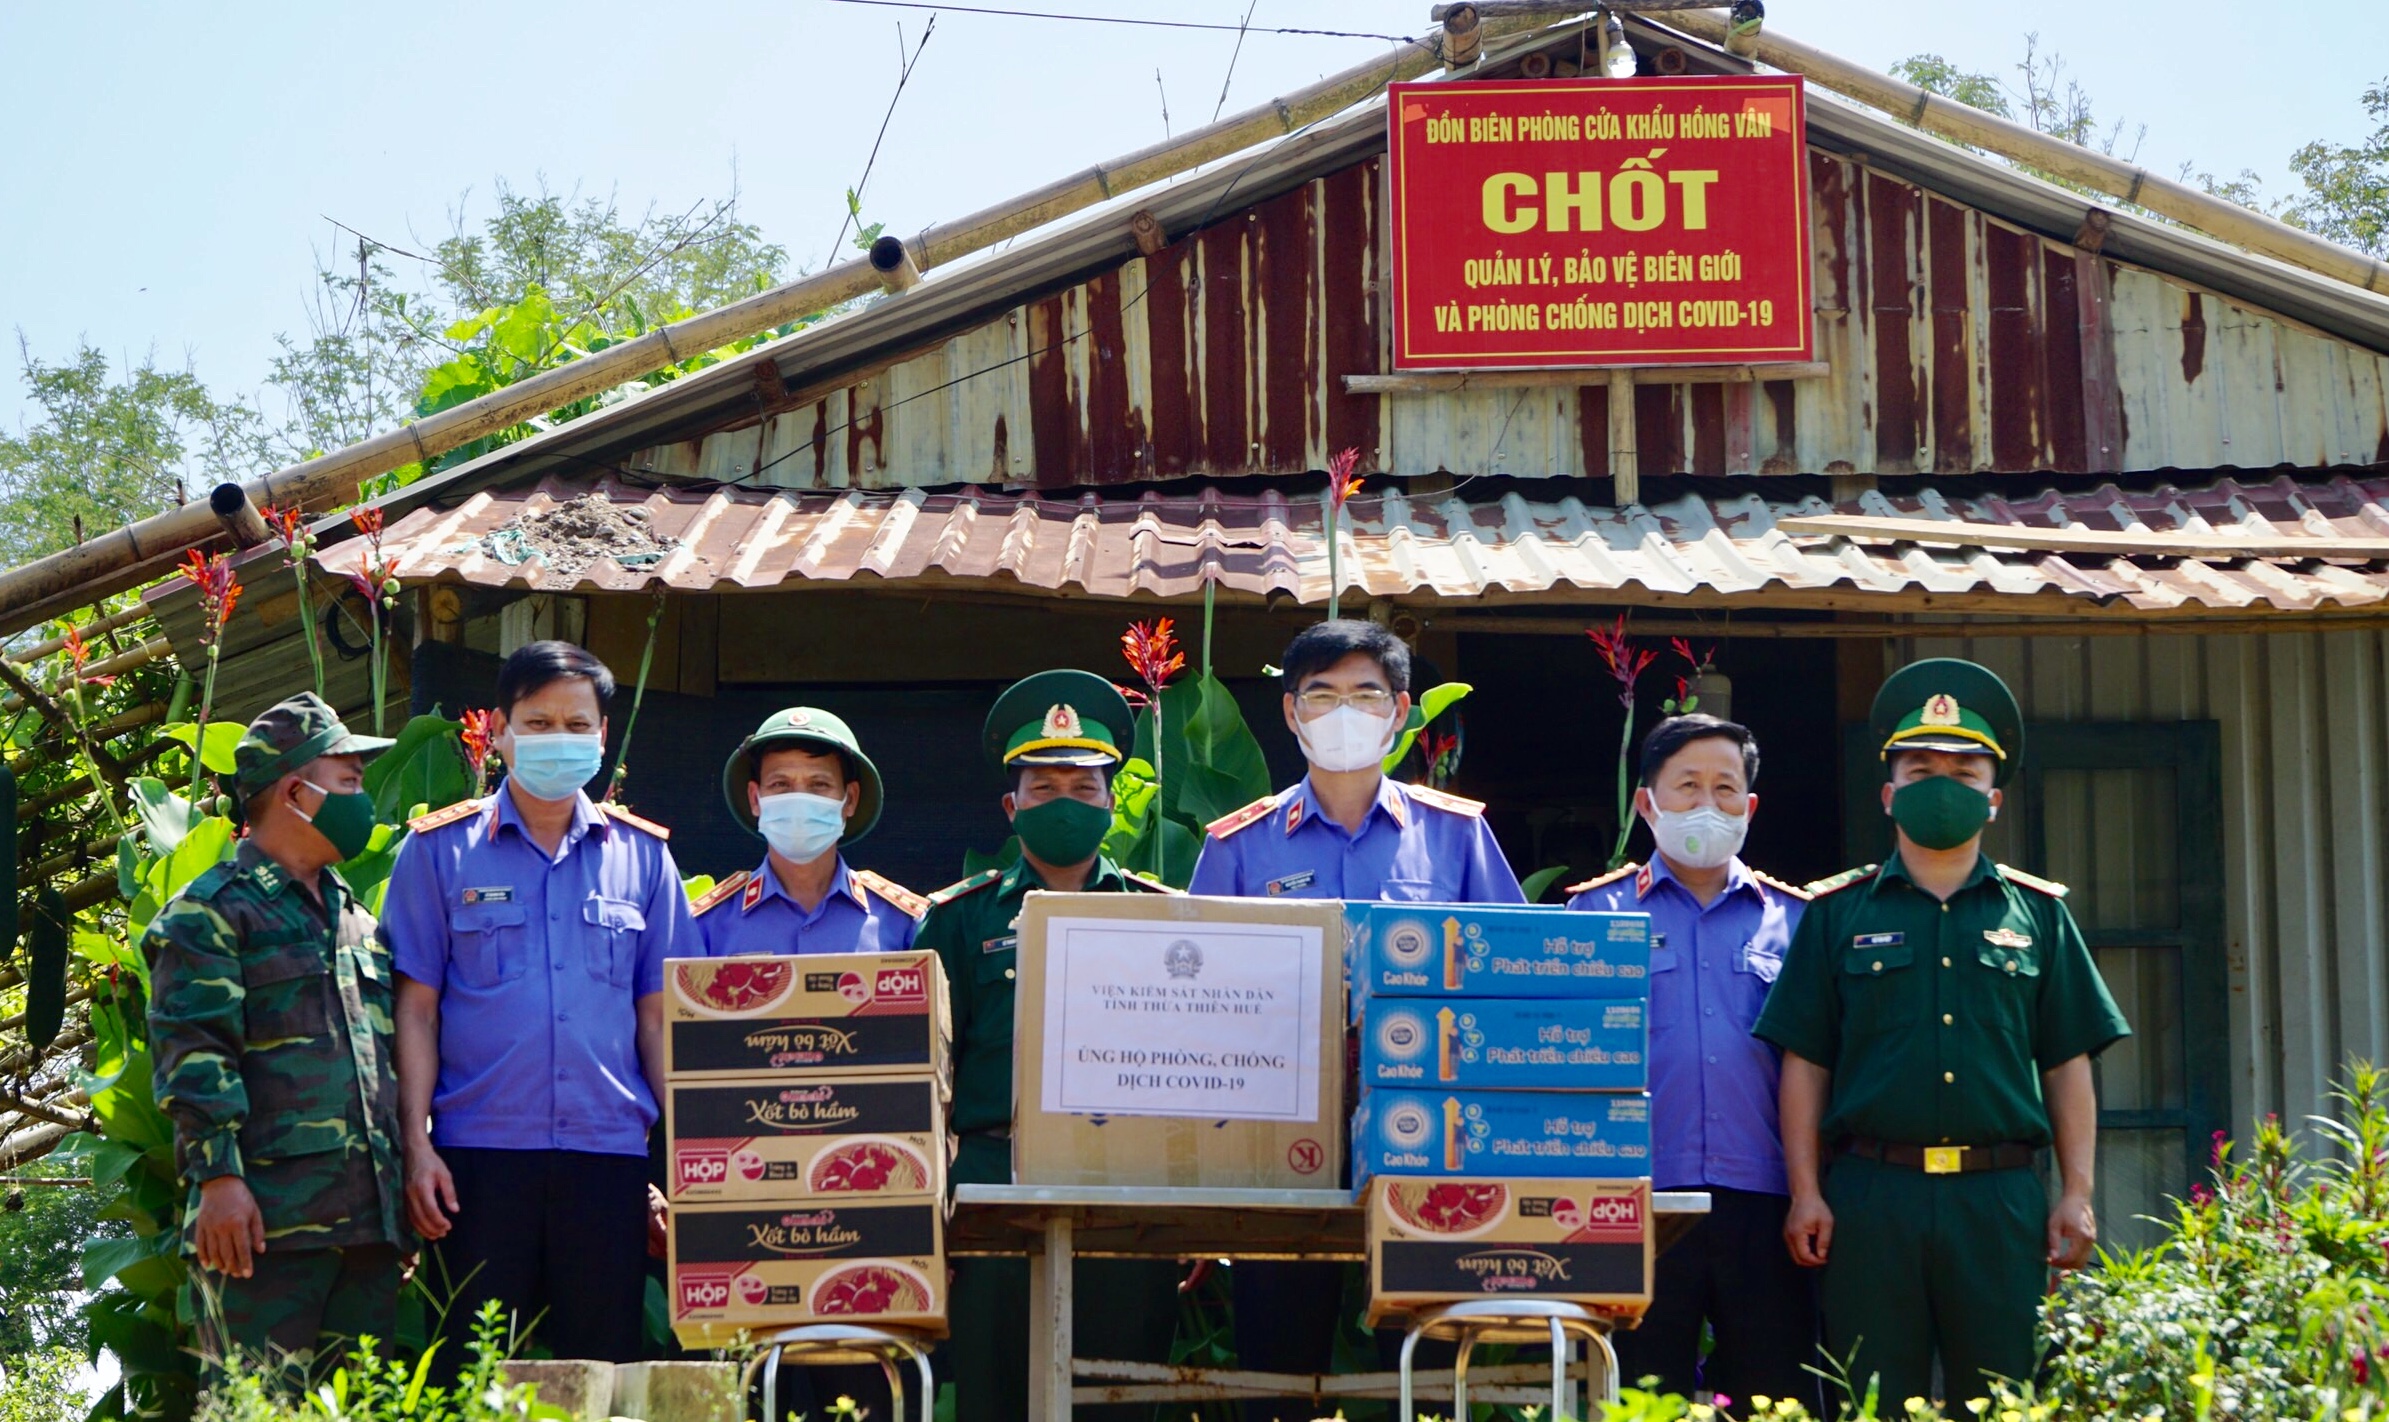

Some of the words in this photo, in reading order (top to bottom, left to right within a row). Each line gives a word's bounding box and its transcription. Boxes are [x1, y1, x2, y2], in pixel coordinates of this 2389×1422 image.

[1426, 109, 1464, 143] ĐỒN
[1470, 111, 1512, 142] BIÊN
[1518, 109, 1580, 141] PHÒNG
[1584, 108, 1621, 140] CỬA
[1626, 104, 1675, 140] KHẨU
[1680, 105, 1730, 139] HỒNG
[1734, 107, 1771, 138] VÂN
[1482, 148, 1719, 234] CHỐT
[1464, 250, 1522, 287] QUẢN
[1528, 252, 1558, 287] LÝ,
[1564, 247, 1606, 284] BẢO
[1612, 250, 1638, 288] VỆ
[1644, 250, 1693, 282] BIÊN
[1699, 249, 1741, 281] GIỚI
[1435, 299, 1463, 332] VÀ
[1468, 299, 1540, 331] PHÒNG
[1545, 293, 1617, 330] CHỐNG
[1624, 301, 1673, 334] DỊCH
[1678, 299, 1773, 328] COVID-19
[877, 970, 919, 995] HỘP
[1092, 985, 1125, 998] VIỆN
[794, 1035, 814, 1050] bò
[1078, 1045, 1115, 1064] ỨNG
[1120, 1048, 1146, 1068] HỘ
[1151, 1048, 1217, 1068] PHÒNG,
[1117, 1073, 1161, 1091] DỊCH
[1166, 1074, 1245, 1090] COVID-19
[788, 1102, 809, 1119] bò
[684, 1158, 725, 1183] HỘP
[1593, 1198, 1634, 1223] HỘP
[790, 1227, 811, 1244] bò
[1507, 1260, 1528, 1275] bò
[686, 1283, 727, 1307] HỘP
